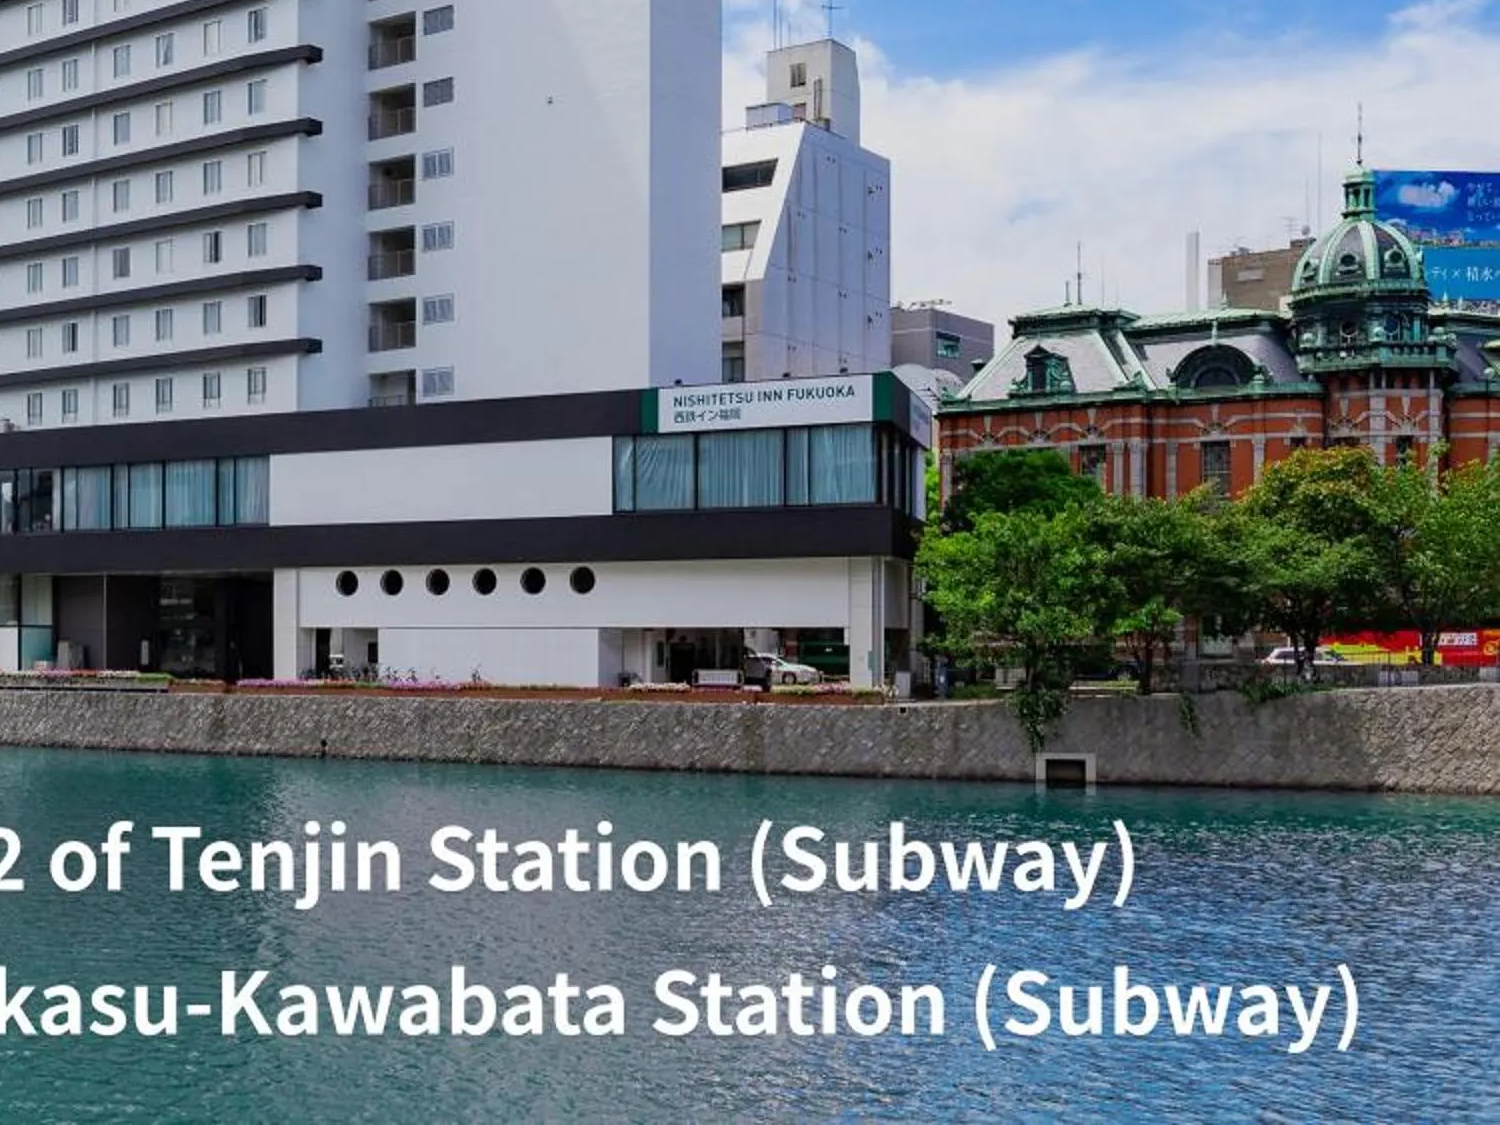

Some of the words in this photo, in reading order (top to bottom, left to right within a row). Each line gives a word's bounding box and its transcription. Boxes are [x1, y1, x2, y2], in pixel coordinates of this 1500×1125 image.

[673, 391, 753, 408] NISHITETSU
[757, 388, 783, 403] INN
[787, 384, 855, 401] FUKUOKA
